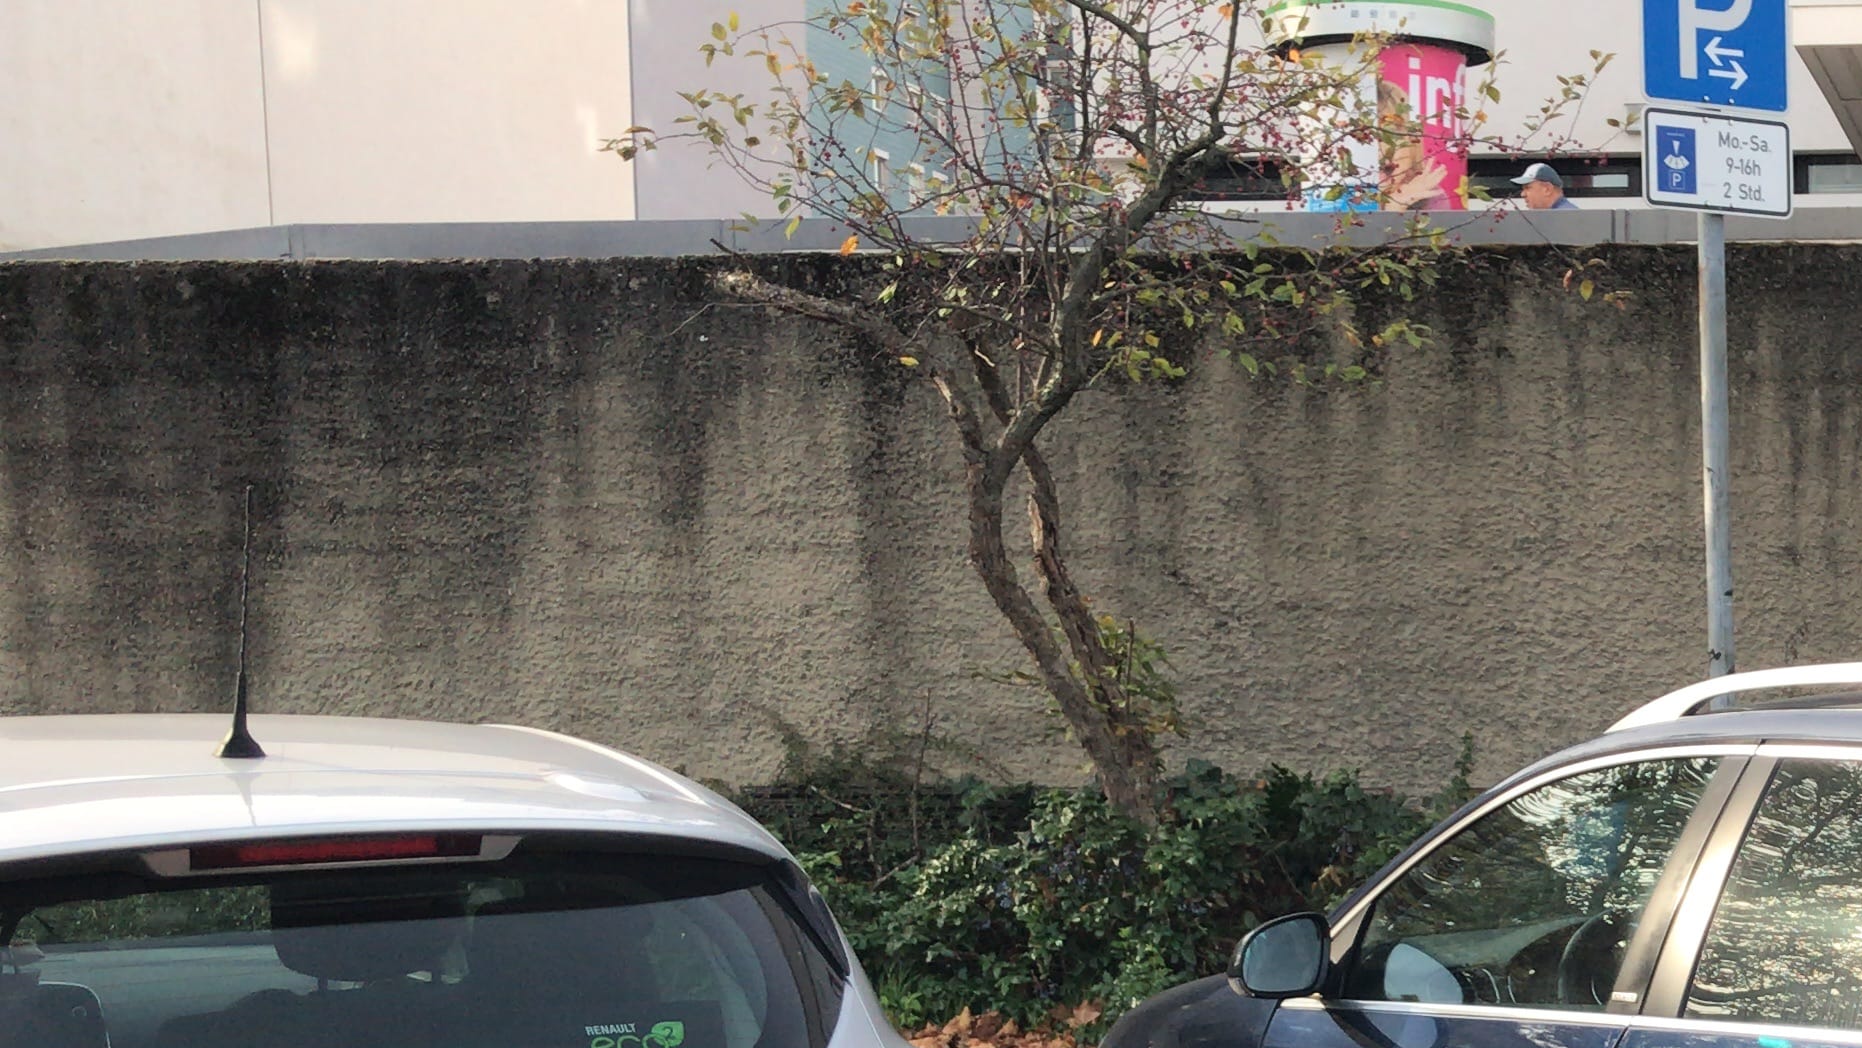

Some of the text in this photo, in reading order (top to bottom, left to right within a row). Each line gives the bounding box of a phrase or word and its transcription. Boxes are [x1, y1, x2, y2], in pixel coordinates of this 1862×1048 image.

[1679, 0, 1753, 80] P
[1726, 158, 1761, 176] 9-16h
[1672, 172, 1682, 187] P
[1723, 183, 1765, 202] 2 Std.
[584, 1023, 636, 1036] RENAULT
